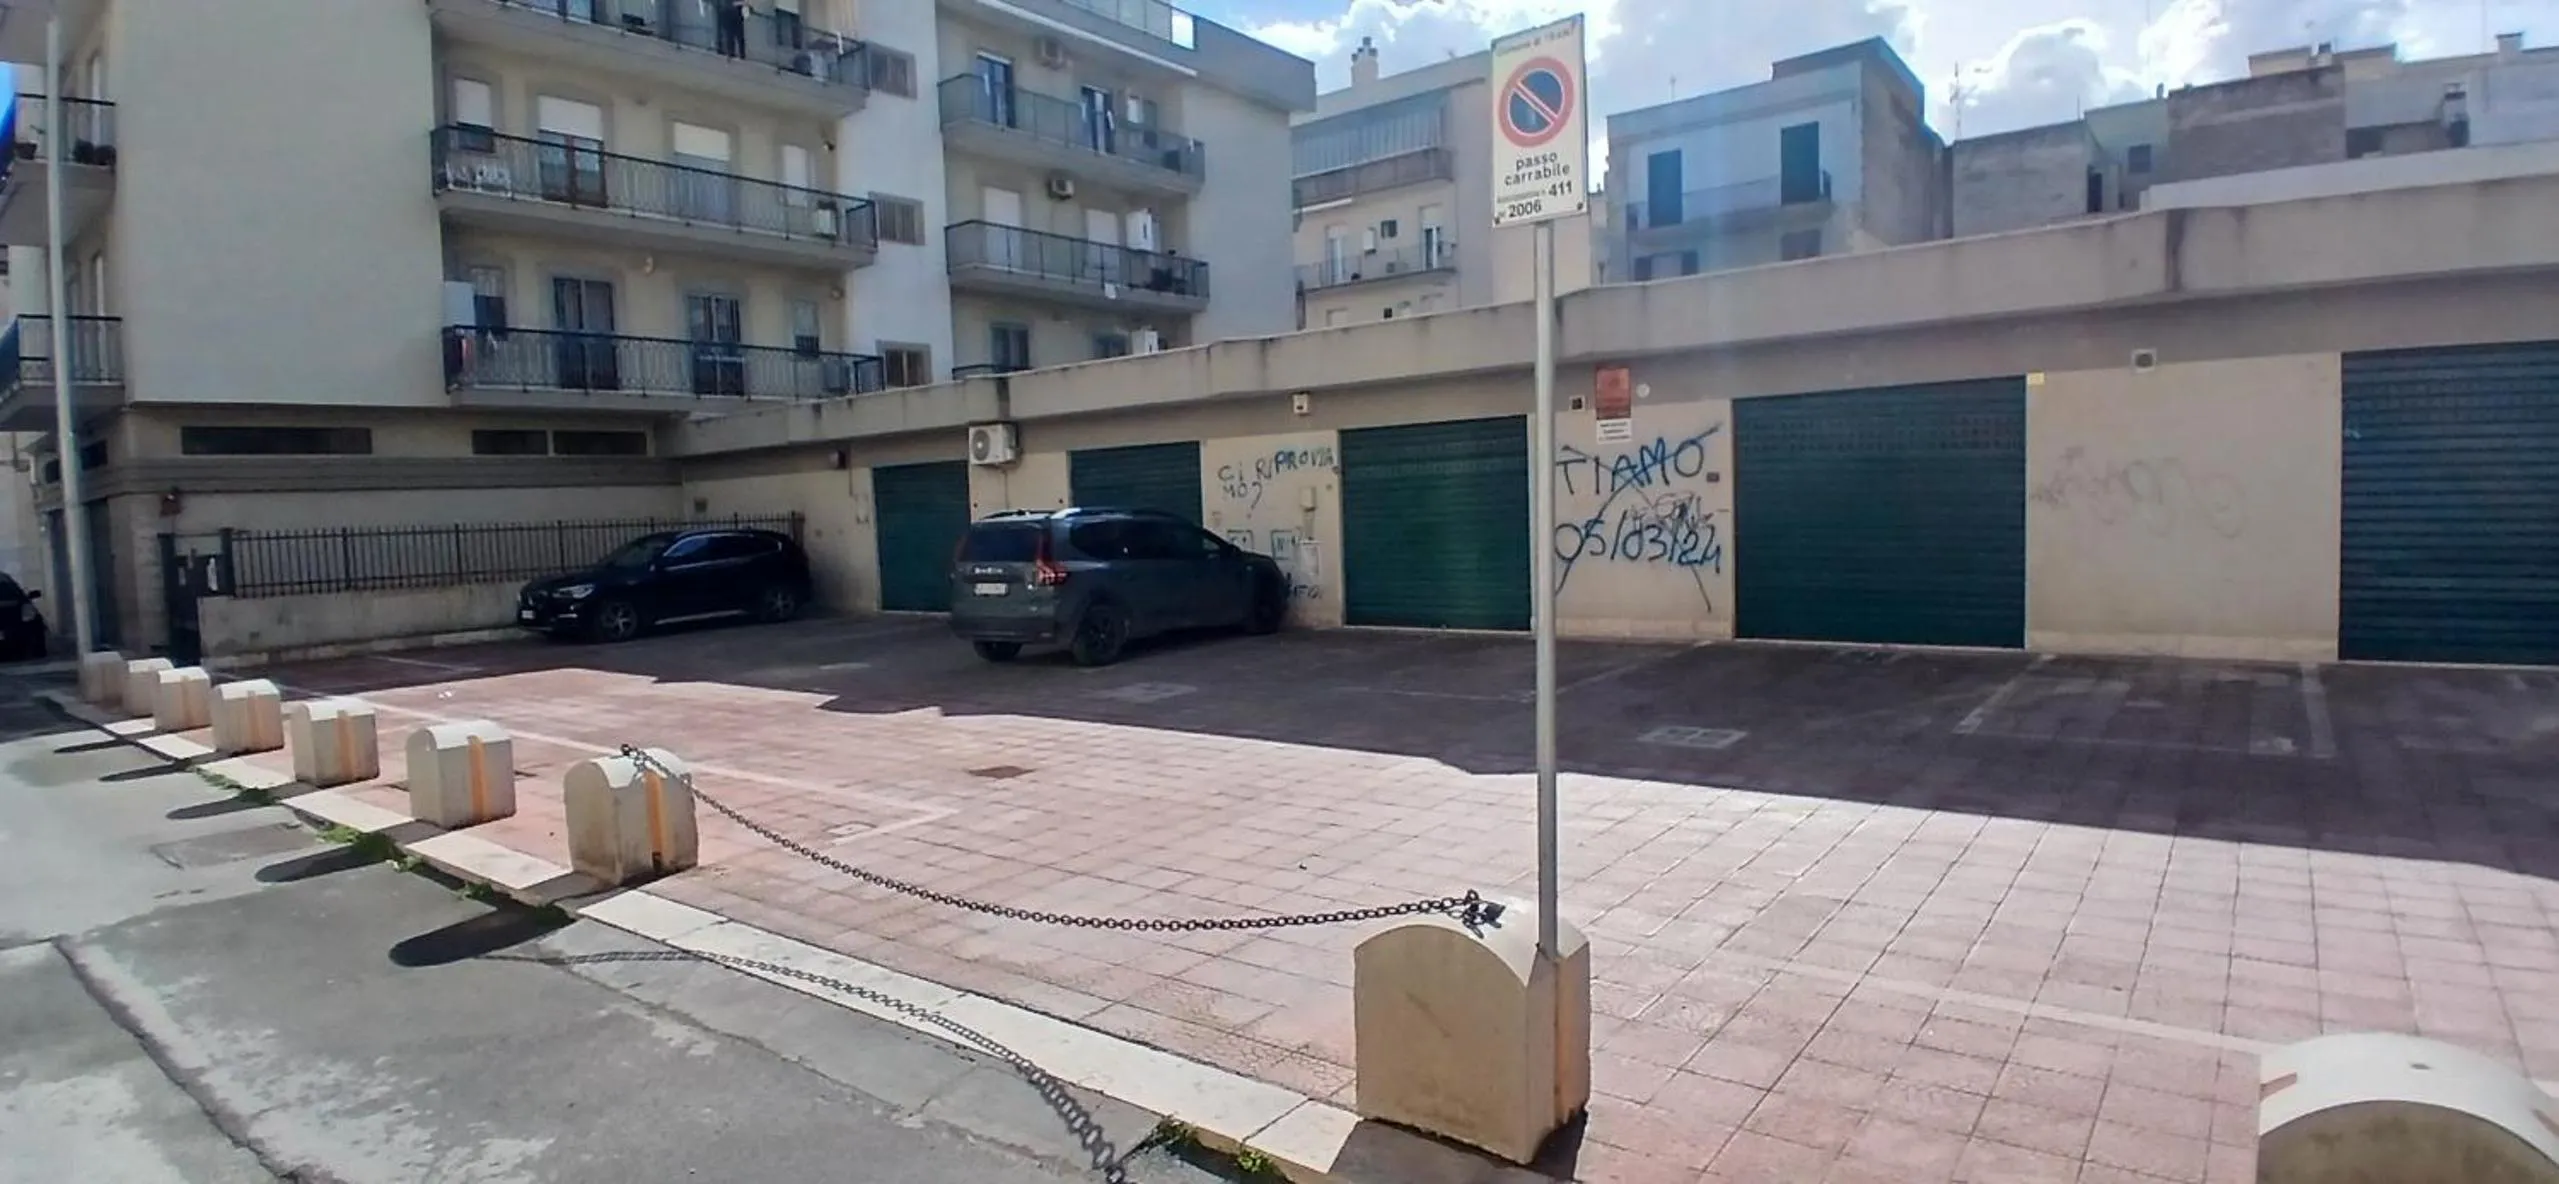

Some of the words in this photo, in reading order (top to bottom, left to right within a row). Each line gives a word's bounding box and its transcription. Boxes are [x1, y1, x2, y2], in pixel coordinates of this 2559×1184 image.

[1516, 152, 1558, 172] passo
[1504, 163, 1570, 186] carrabile
[1548, 180, 1573, 196] 411
[1508, 199, 1542, 218] 2006
